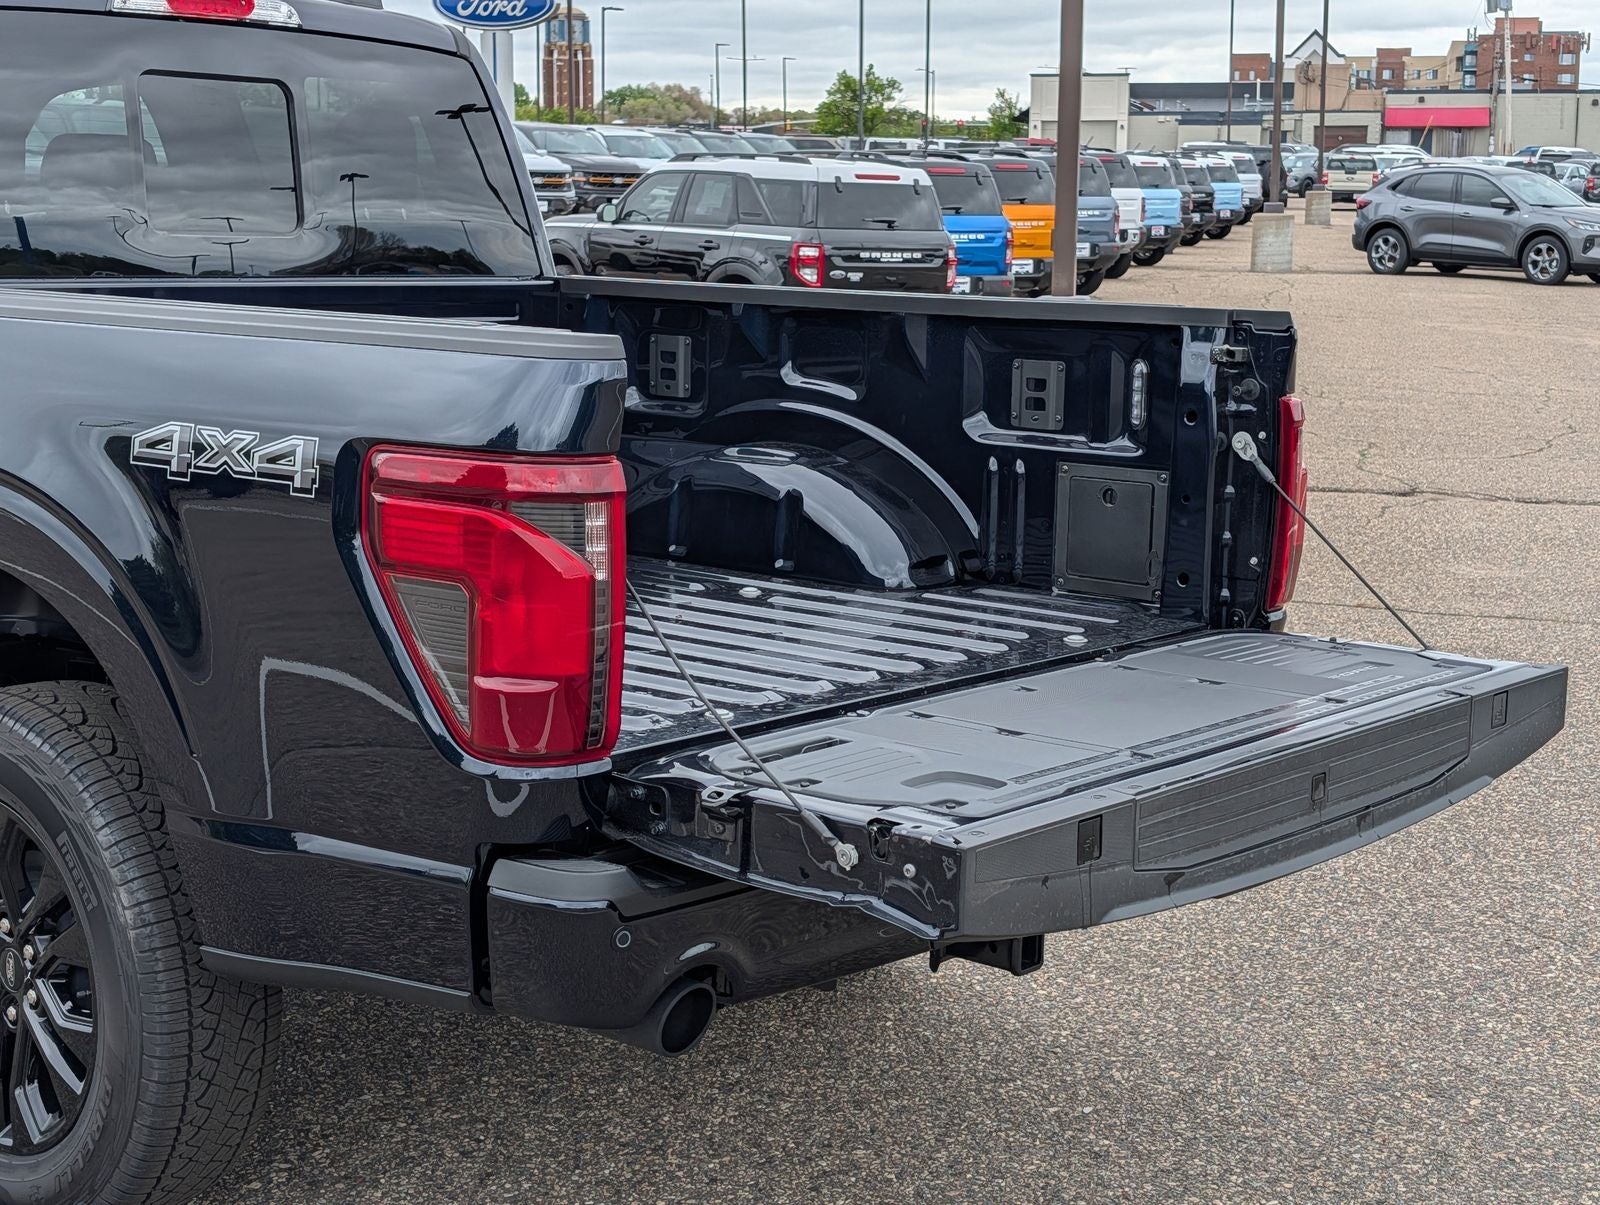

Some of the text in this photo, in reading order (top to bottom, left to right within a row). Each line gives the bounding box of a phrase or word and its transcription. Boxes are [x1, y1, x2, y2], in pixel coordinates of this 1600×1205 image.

[859, 251, 922, 259] BRONCO
[415, 600, 466, 613] FORD
[55, 830, 98, 912] PIRELLI
[55, 1076, 113, 1194] PIRELLI
